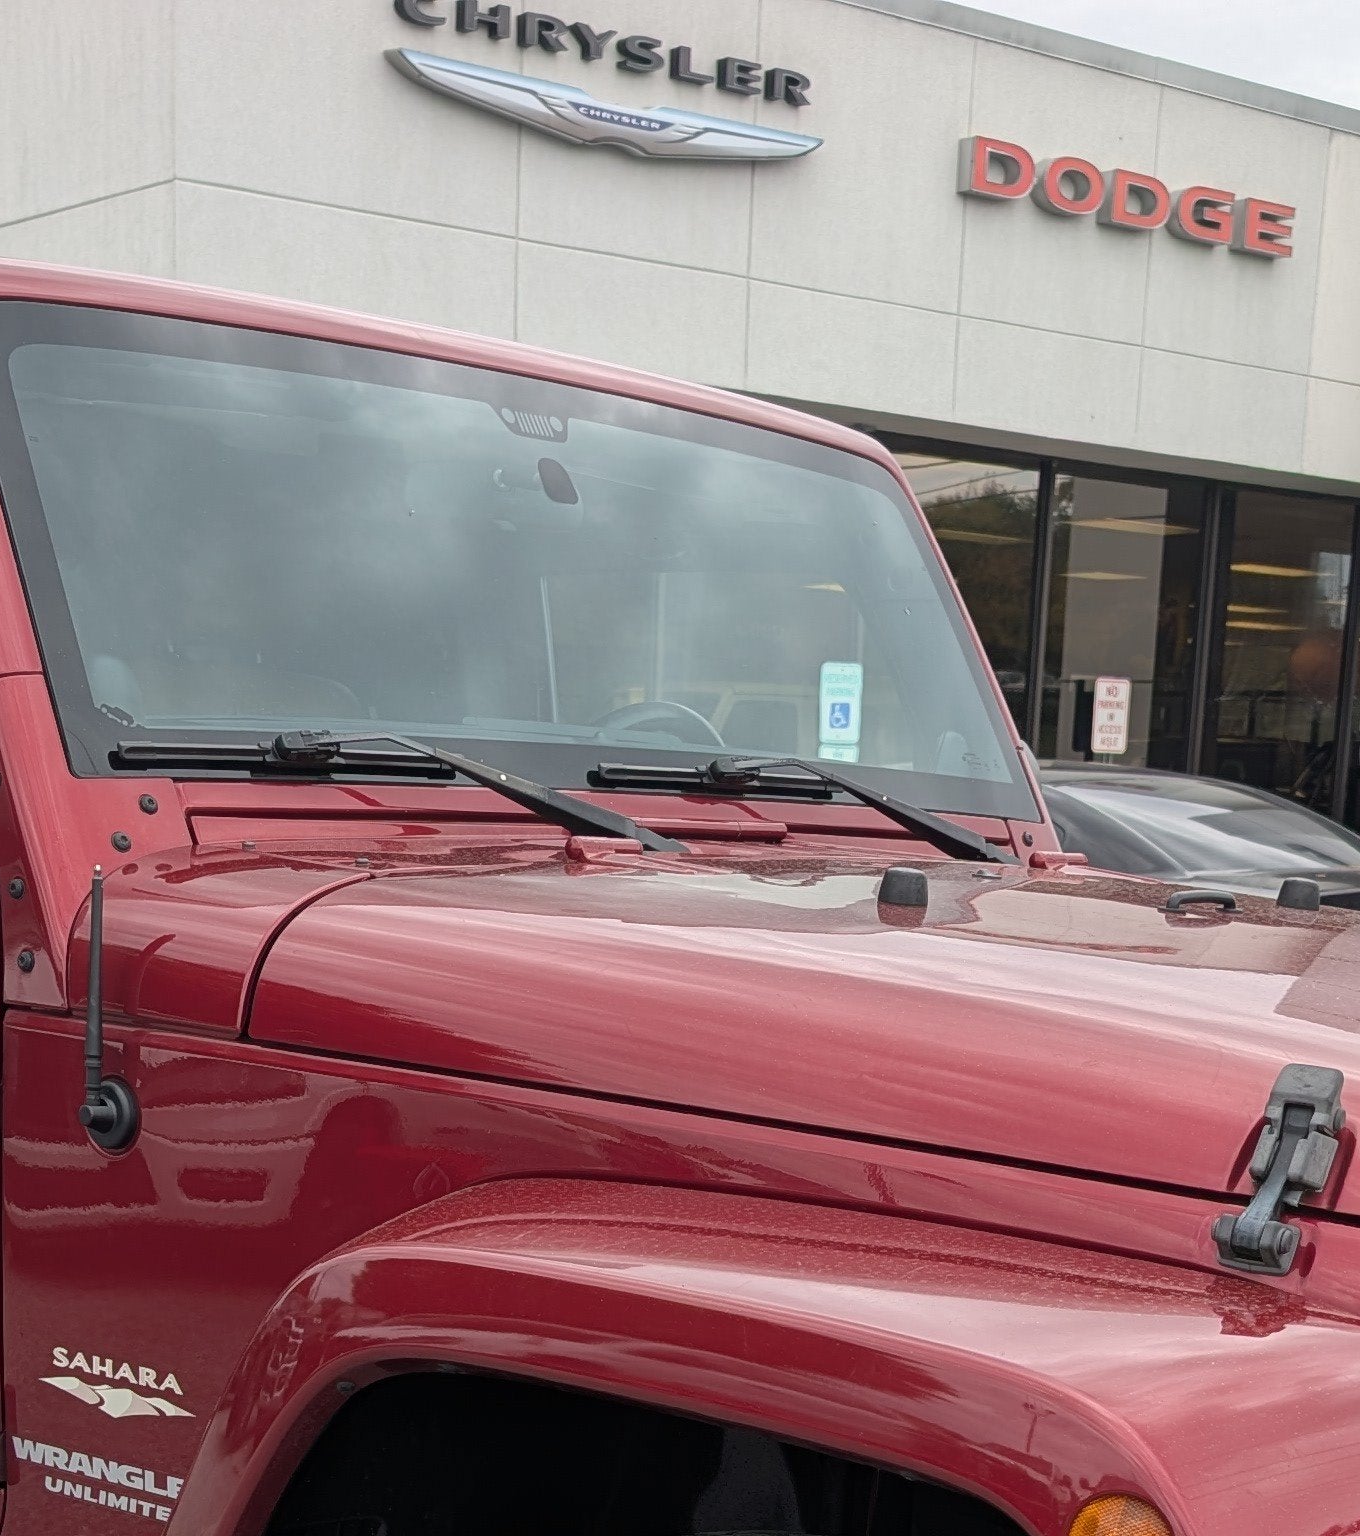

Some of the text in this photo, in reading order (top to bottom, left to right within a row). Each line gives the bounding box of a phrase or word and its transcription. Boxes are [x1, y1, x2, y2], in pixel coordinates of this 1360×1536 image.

[394, 0, 811, 106] CHRYSLER
[579, 106, 660, 130] CHRYSLER
[957, 135, 1297, 259] DODGE
[52, 1346, 184, 1396] SAHARA
[44, 1475, 172, 1522] UNLIMITE
